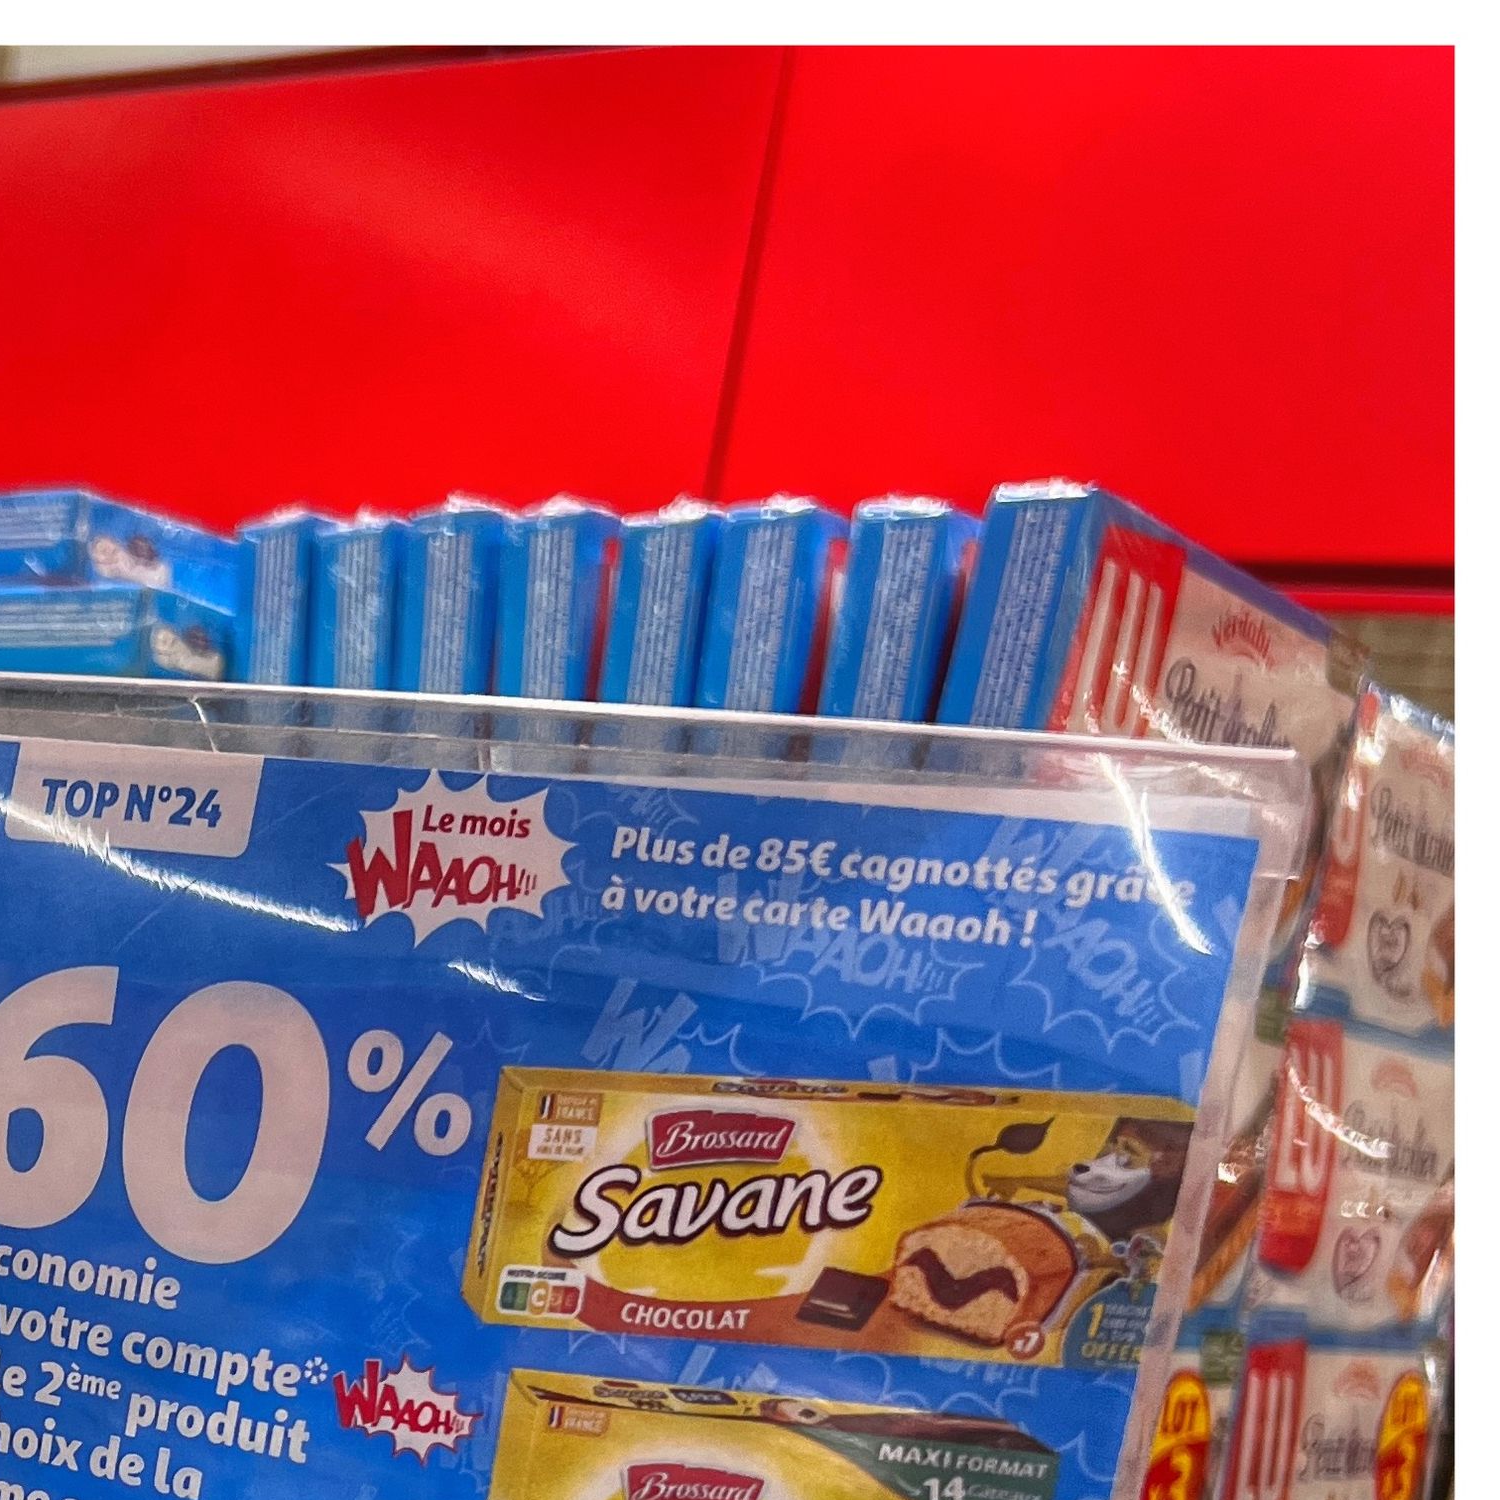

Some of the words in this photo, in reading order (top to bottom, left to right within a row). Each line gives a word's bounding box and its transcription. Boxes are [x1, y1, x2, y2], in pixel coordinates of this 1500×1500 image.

[41, 778, 119, 821] TOP
[423, 804, 455, 833] Le
[459, 809, 532, 838] mois
[610, 825, 695, 866] Plus
[701, 834, 750, 870] de
[756, 837, 838, 877] 85€
[841, 850, 1057, 893] cagnottés
[601, 876, 627, 912] à
[634, 885, 736, 921] votre
[742, 890, 848, 931] carte
[859, 898, 1011, 947] Waaoh
[656, 1119, 787, 1158] Brossard
[551, 1163, 884, 1259] Savane
[621, 1302, 750, 1330] CHOCOLAT
[124, 1391, 310, 1465] produit
[89, 1435, 144, 1487] de
[153, 1447, 204, 1500] la
[878, 1442, 951, 1469] MAXI
[955, 1454, 1049, 1479] FORMAT
